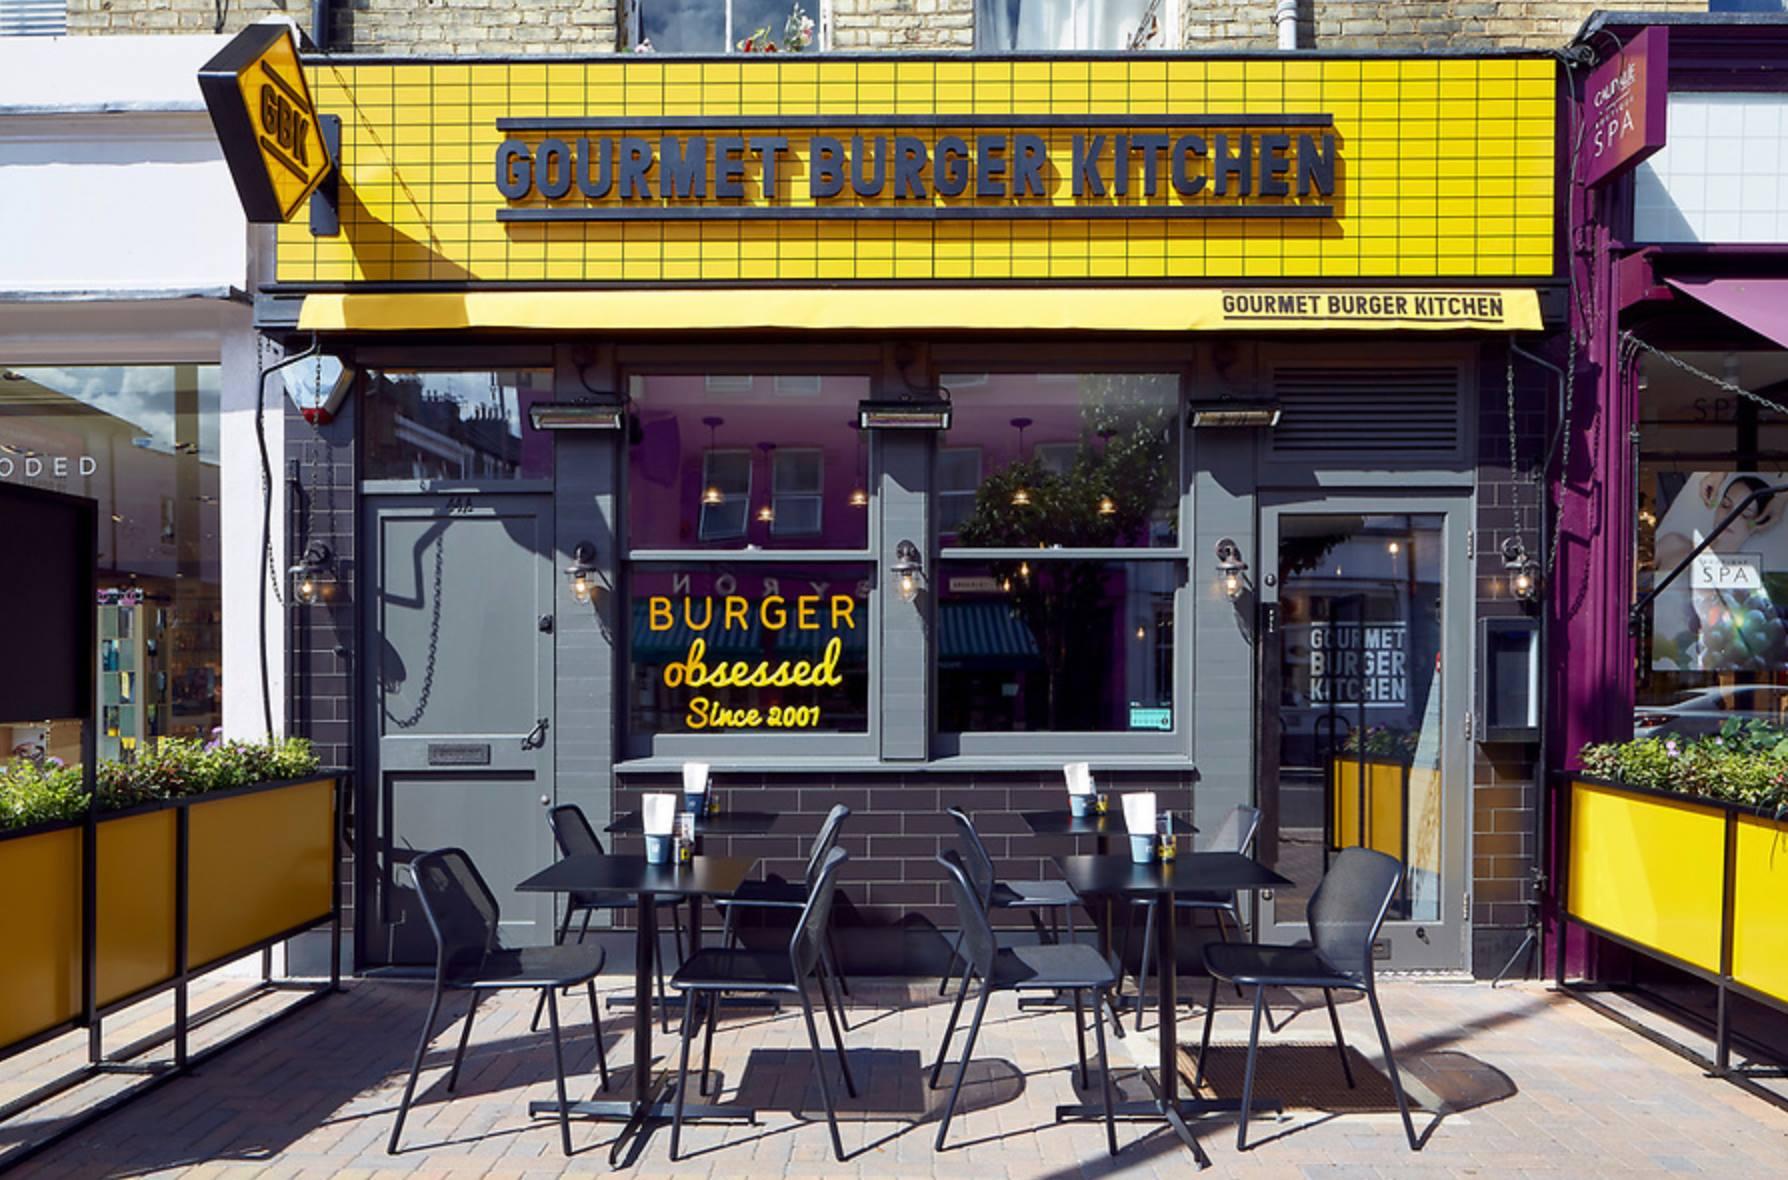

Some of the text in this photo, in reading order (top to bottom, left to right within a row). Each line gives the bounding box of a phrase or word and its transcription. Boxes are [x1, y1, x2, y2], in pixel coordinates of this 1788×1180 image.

[261, 84, 309, 168] GBK
[1594, 110, 1634, 157] SPA
[496, 134, 1335, 200] GOURMET BURGER KITCHEN
[1223, 295, 1504, 317] GOURMET BURGER KITCHEN
[1694, 399, 1729, 420] SP
[0, 456, 97, 477] ODED
[1703, 567, 1749, 583] SPA
[650, 595, 856, 631] BURGER
[1311, 628, 1407, 649] GOURMET
[664, 636, 843, 688] obsessed
[1311, 651, 1406, 676] BURGER
[1311, 678, 1406, 700] KITCHEN
[686, 697, 820, 729] Since 2001
